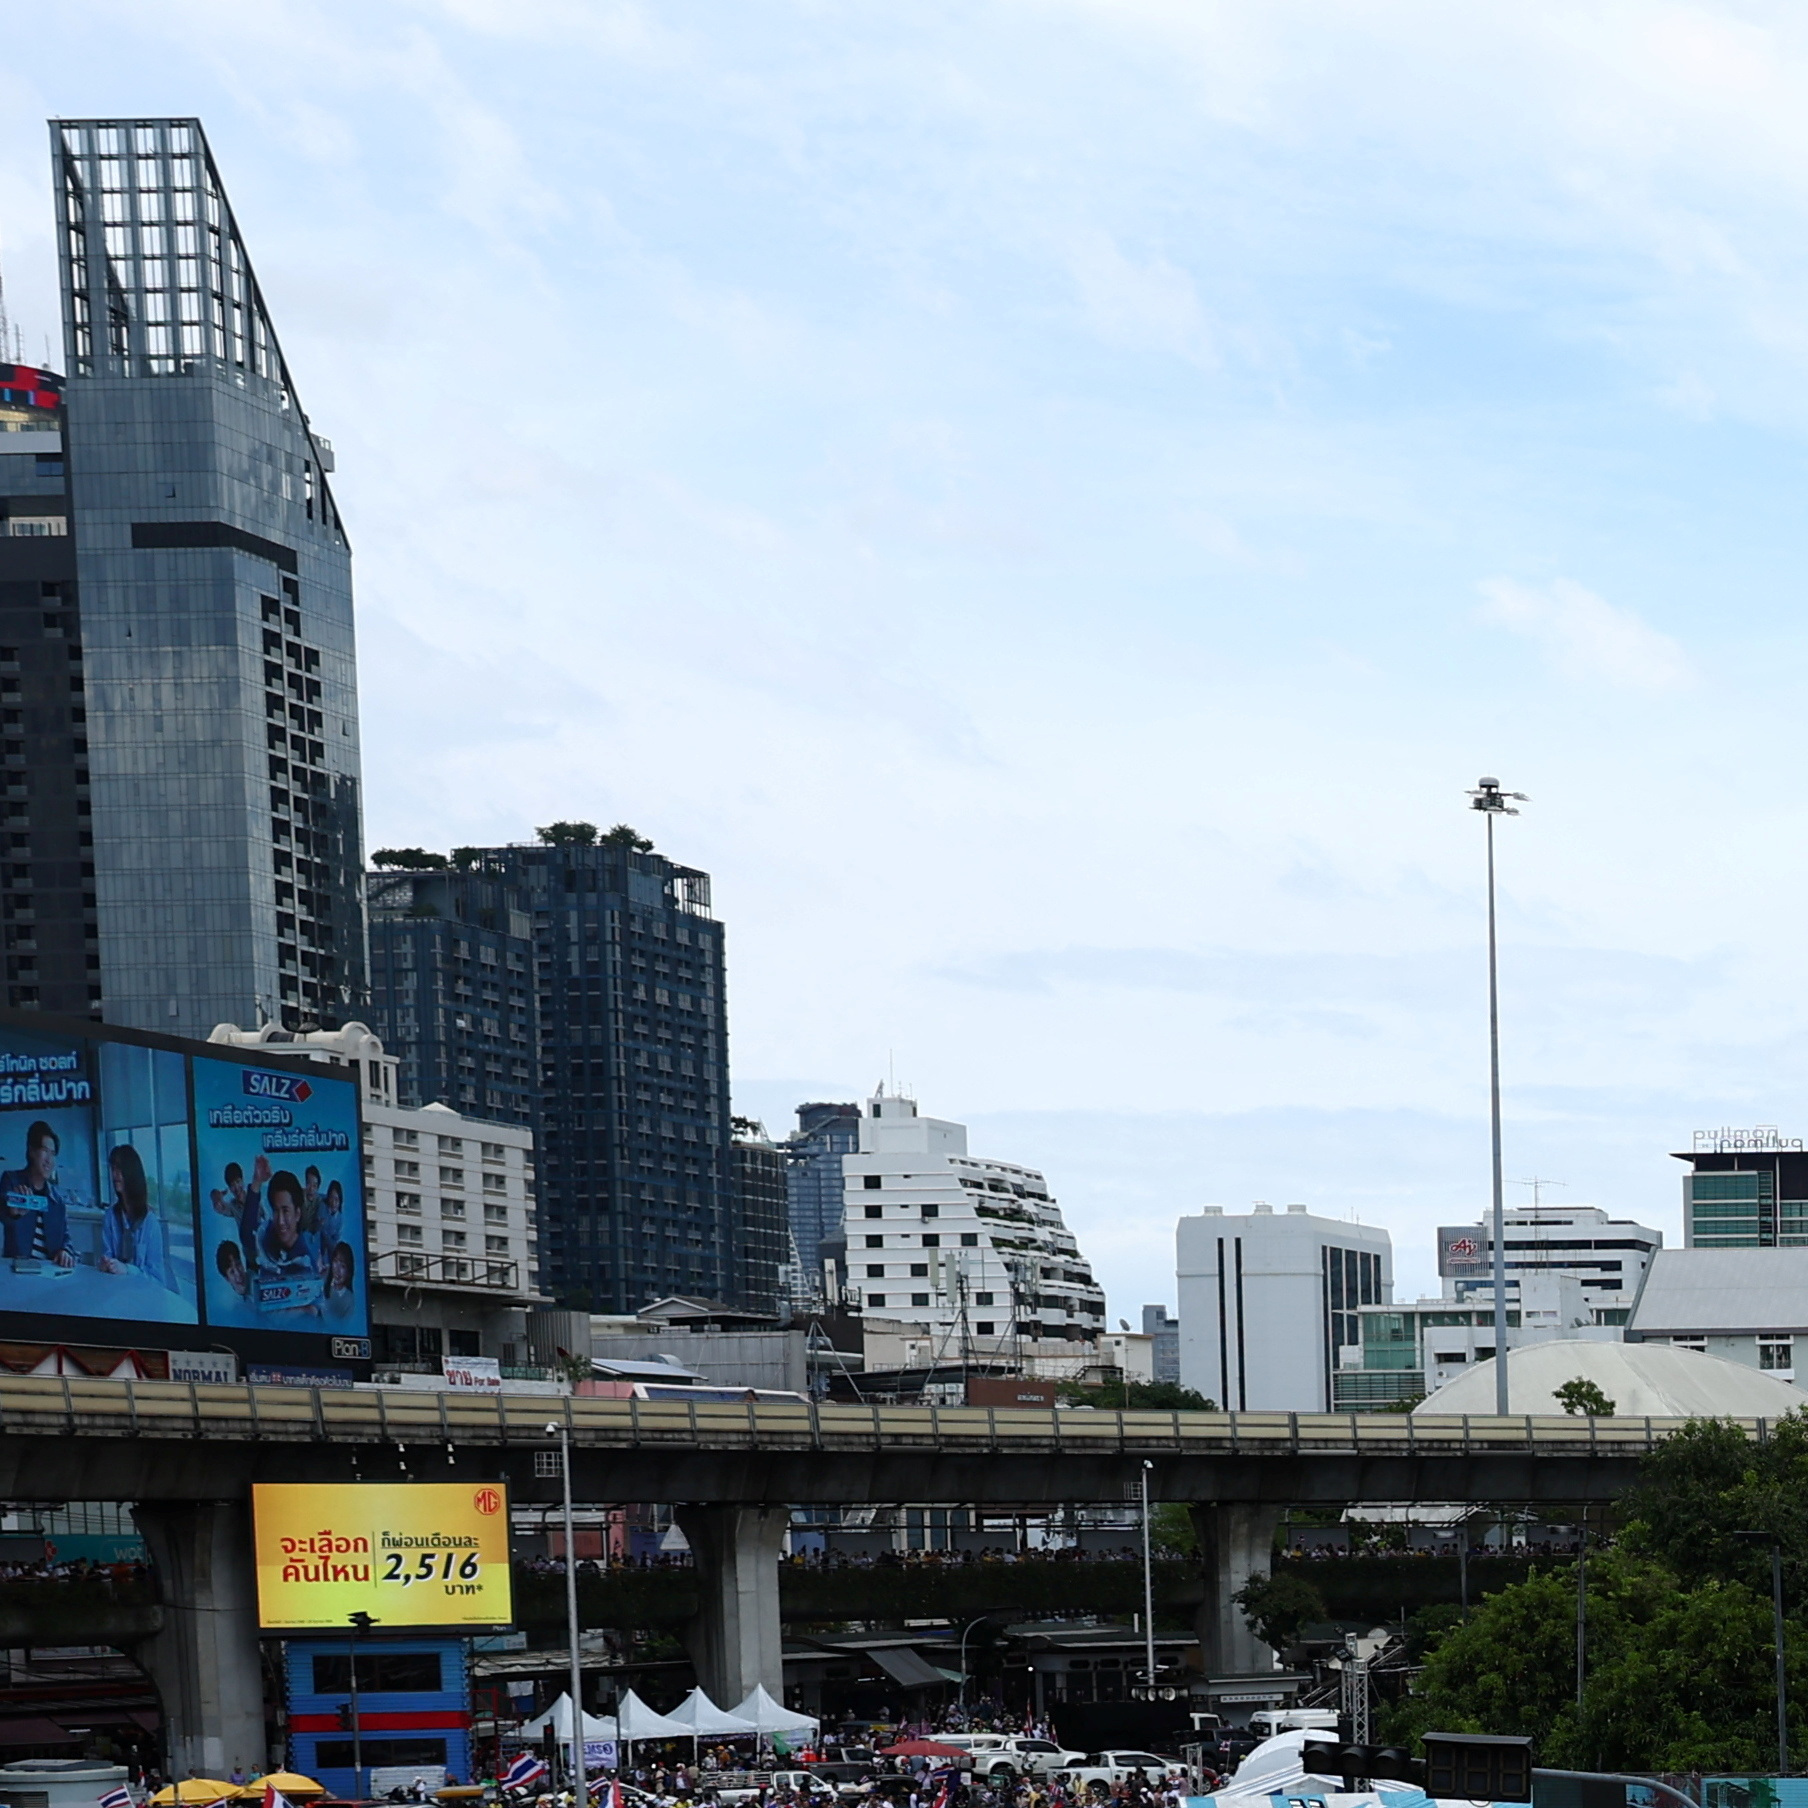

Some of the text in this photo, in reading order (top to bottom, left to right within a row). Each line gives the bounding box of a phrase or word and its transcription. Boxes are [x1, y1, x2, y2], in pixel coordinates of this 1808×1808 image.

[249, 1075, 292, 1100] SALZ
[476, 1490, 499, 1514] MG
[280, 1530, 369, 1553] จะเลือก
[381, 1531, 480, 1548] ก็ผ่อนเดือนละ
[282, 1555, 370, 1582] คันไหน
[381, 1552, 480, 1588] 2,516
